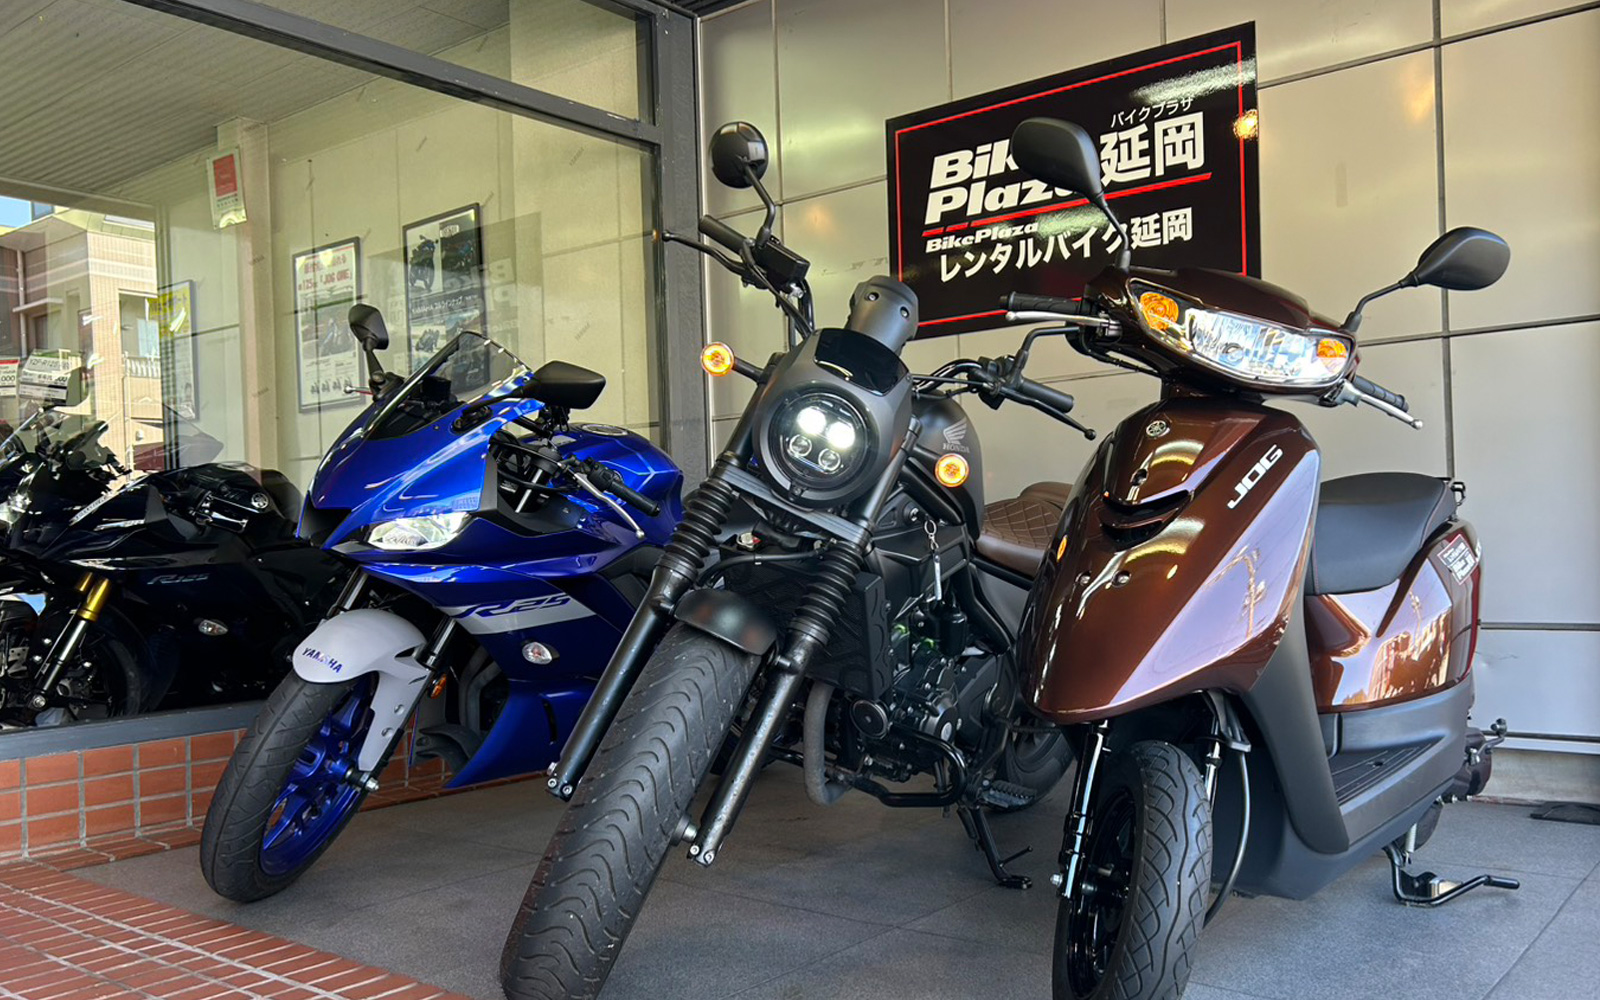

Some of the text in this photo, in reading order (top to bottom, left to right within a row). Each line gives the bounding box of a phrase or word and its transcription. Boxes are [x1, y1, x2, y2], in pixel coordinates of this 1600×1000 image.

[930, 138, 1020, 189] Bik
[1100, 111, 1205, 187] 延岡
[925, 222, 1039, 253] BikePlaza
[940, 207, 1193, 283] レンタルバイク延岡
[942, 442, 970, 453] HONDA
[1227, 444, 1283, 509] JOG
[302, 647, 342, 673] YAMHA
